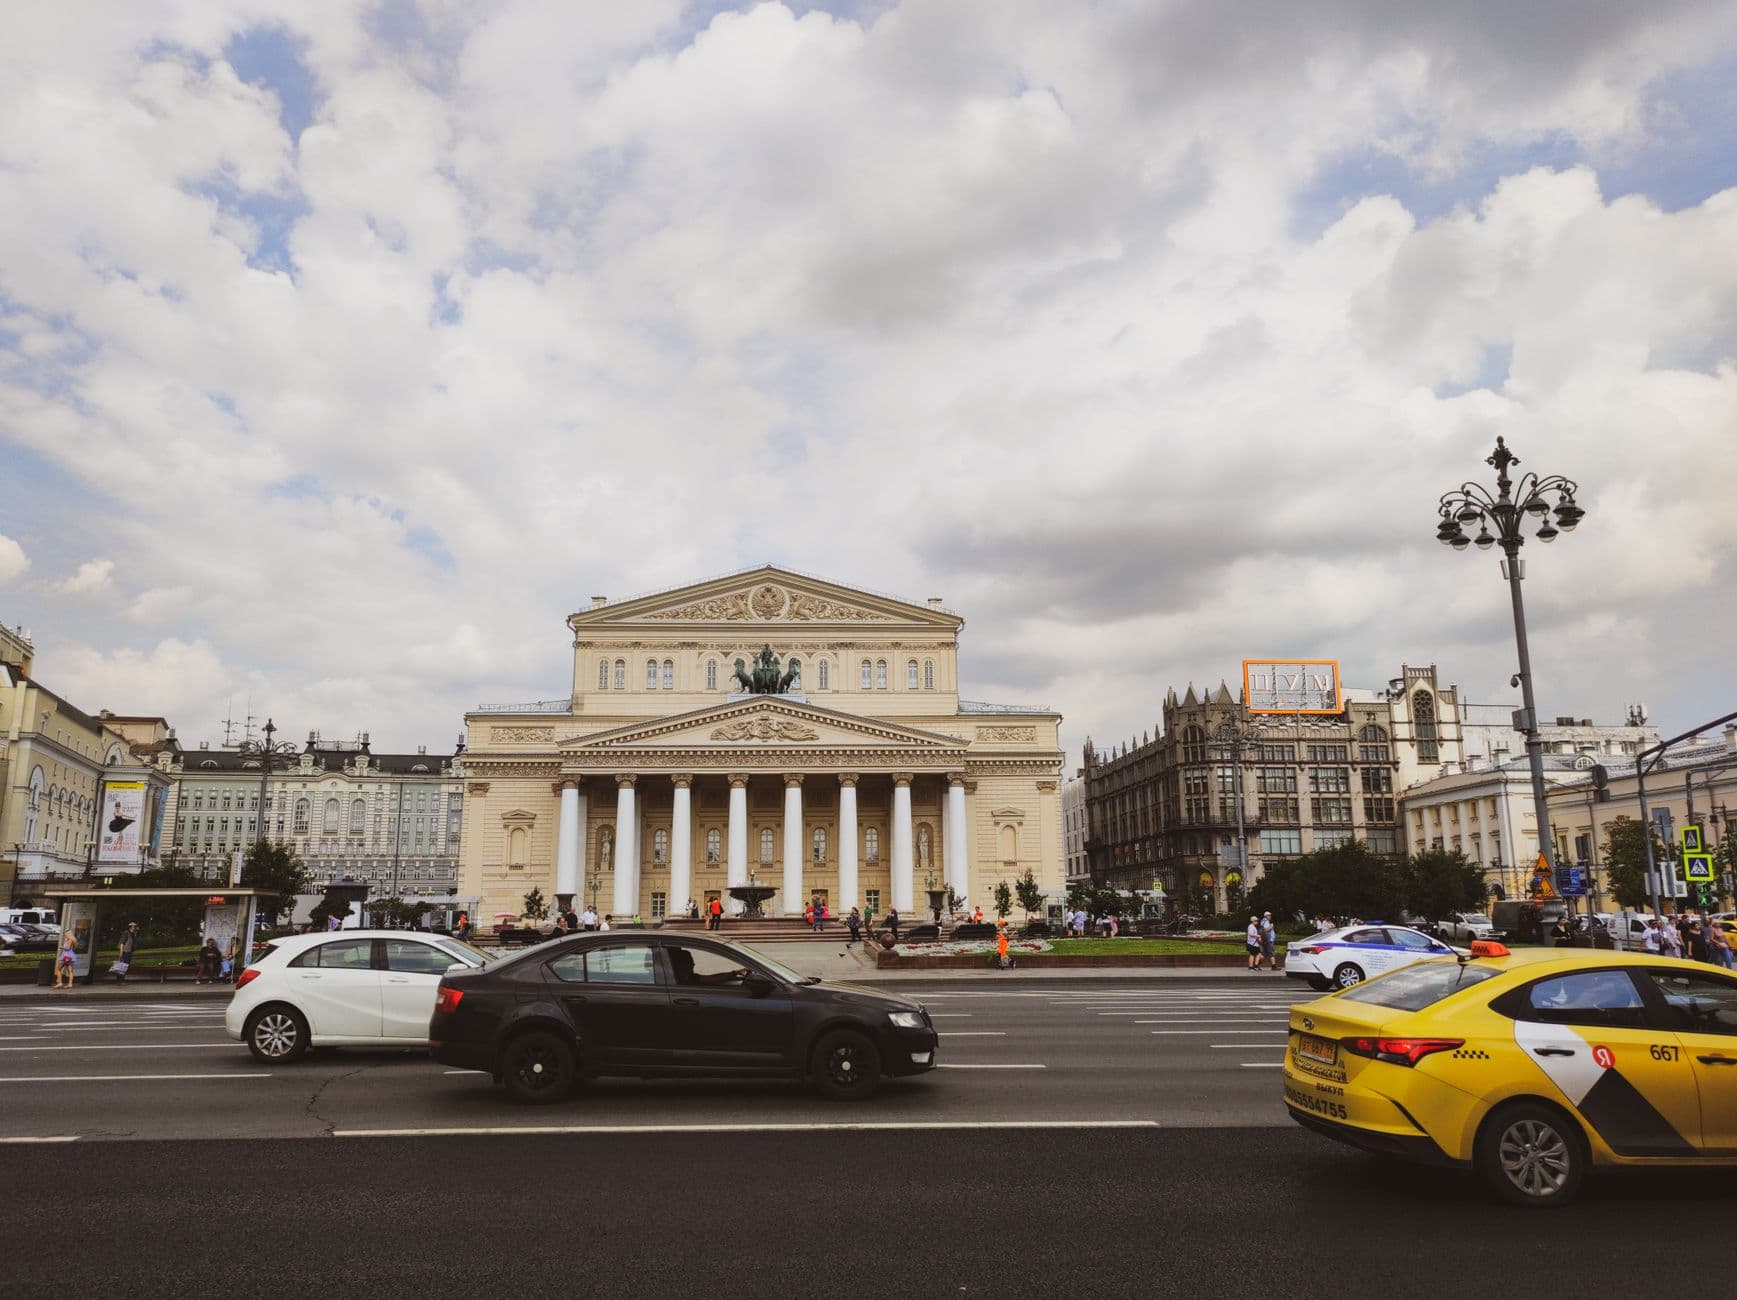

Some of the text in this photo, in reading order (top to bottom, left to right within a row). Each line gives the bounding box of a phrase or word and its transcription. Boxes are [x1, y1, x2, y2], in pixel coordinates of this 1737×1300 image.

[1597, 1048, 1611, 1066] Я
[1649, 1044, 1679, 1062] 667
[1316, 1082, 1344, 1096] ВЫКУП
